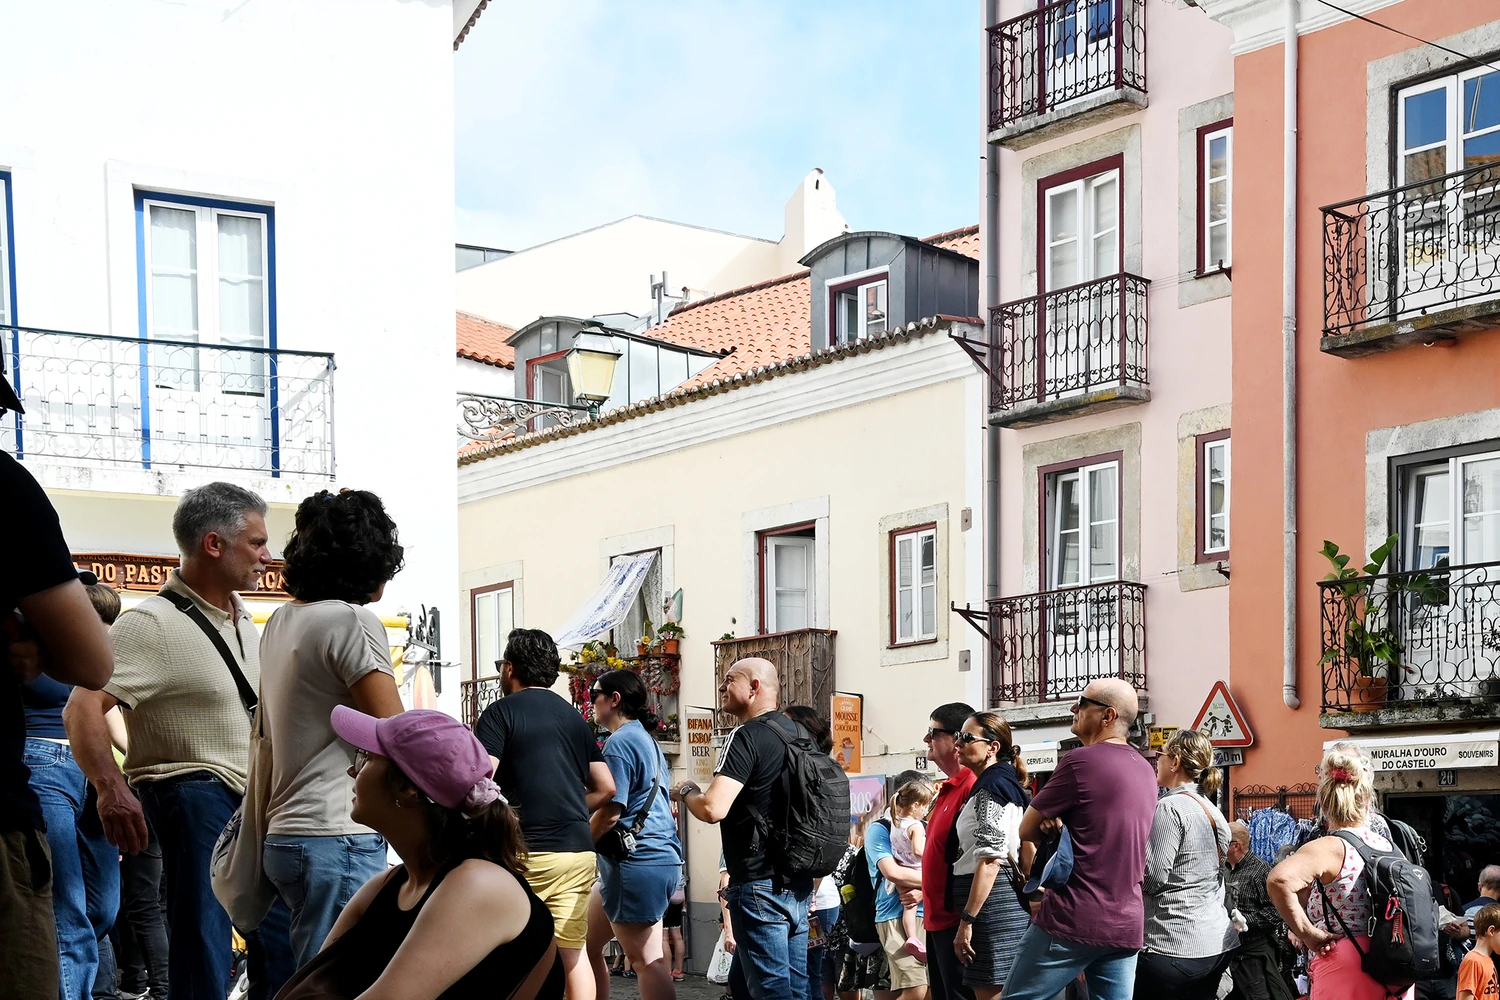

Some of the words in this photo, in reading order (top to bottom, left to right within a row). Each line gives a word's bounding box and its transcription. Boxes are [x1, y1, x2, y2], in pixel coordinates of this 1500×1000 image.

[92, 562, 117, 582] DO
[125, 564, 174, 584] PAST
[835, 711, 858, 721] MOUSSE
[687, 718, 713, 731] BIFANA
[834, 723, 858, 732] CHOCOLAT
[691, 746, 711, 757] BEER
[1371, 749, 1412, 759] MURALHA
[1414, 747, 1447, 757] D'OURO
[1458, 750, 1494, 759] SOUVENIRS
[1026, 757, 1054, 765] CERVEJARIA
[1382, 760, 1394, 769] DO
[1396, 759, 1436, 768] CASTELO
[1440, 771, 1453, 785] 20
[851, 791, 872, 814] ROS
